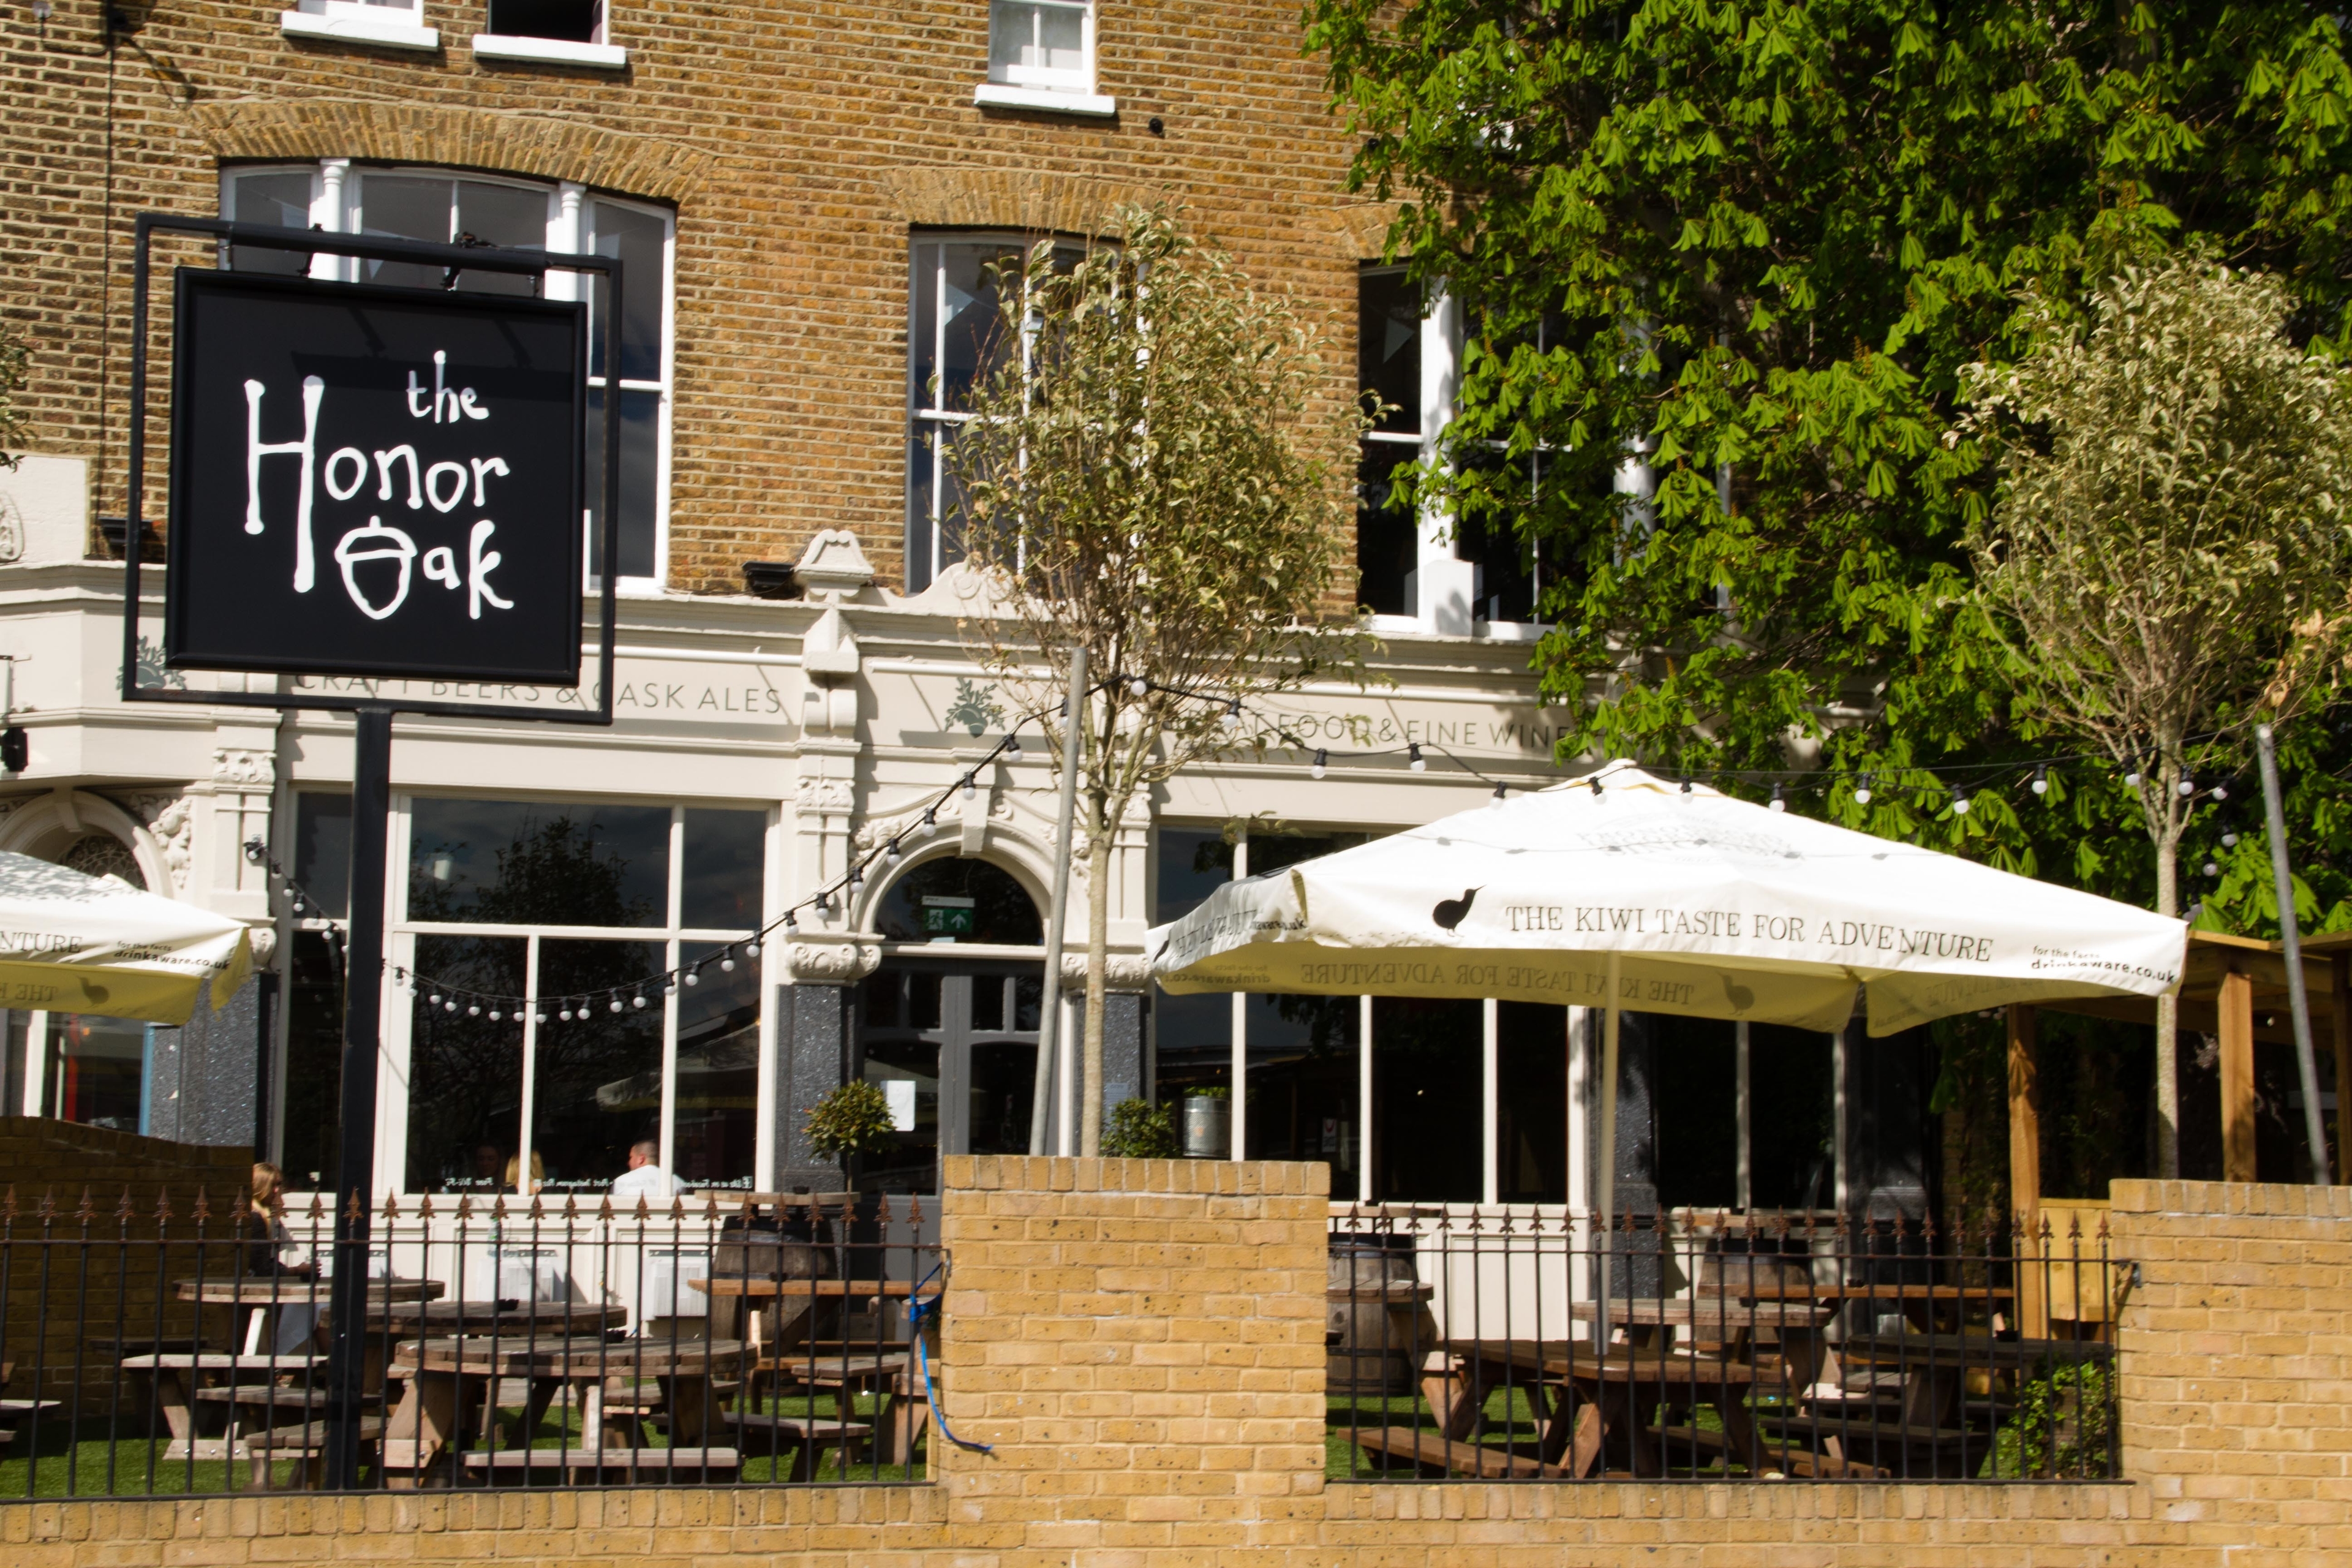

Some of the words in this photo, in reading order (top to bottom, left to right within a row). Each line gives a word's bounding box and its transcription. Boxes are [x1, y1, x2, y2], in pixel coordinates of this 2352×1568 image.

[406, 350, 489, 424] the
[244, 375, 511, 593] Honor
[334, 516, 514, 620] Oak
[431, 681, 540, 701] BEERS
[697, 686, 780, 714] ALES
[1378, 717, 1398, 742] &
[1408, 720, 1477, 745] FINE
[1488, 722, 1570, 748] WINE
[1506, 906, 1563, 932] THE
[1575, 907, 1646, 933] KIWI
[1655, 909, 1741, 937] TASTE
[1752, 914, 1806, 941] FOR
[1817, 921, 1994, 962] ADVENTURE
[114, 950, 231, 970] drinkaware.co.uk
[2032, 944, 2048, 956] for
[2051, 948, 2068, 959] the
[2031, 959, 2176, 984] drinkaware.co.uk
